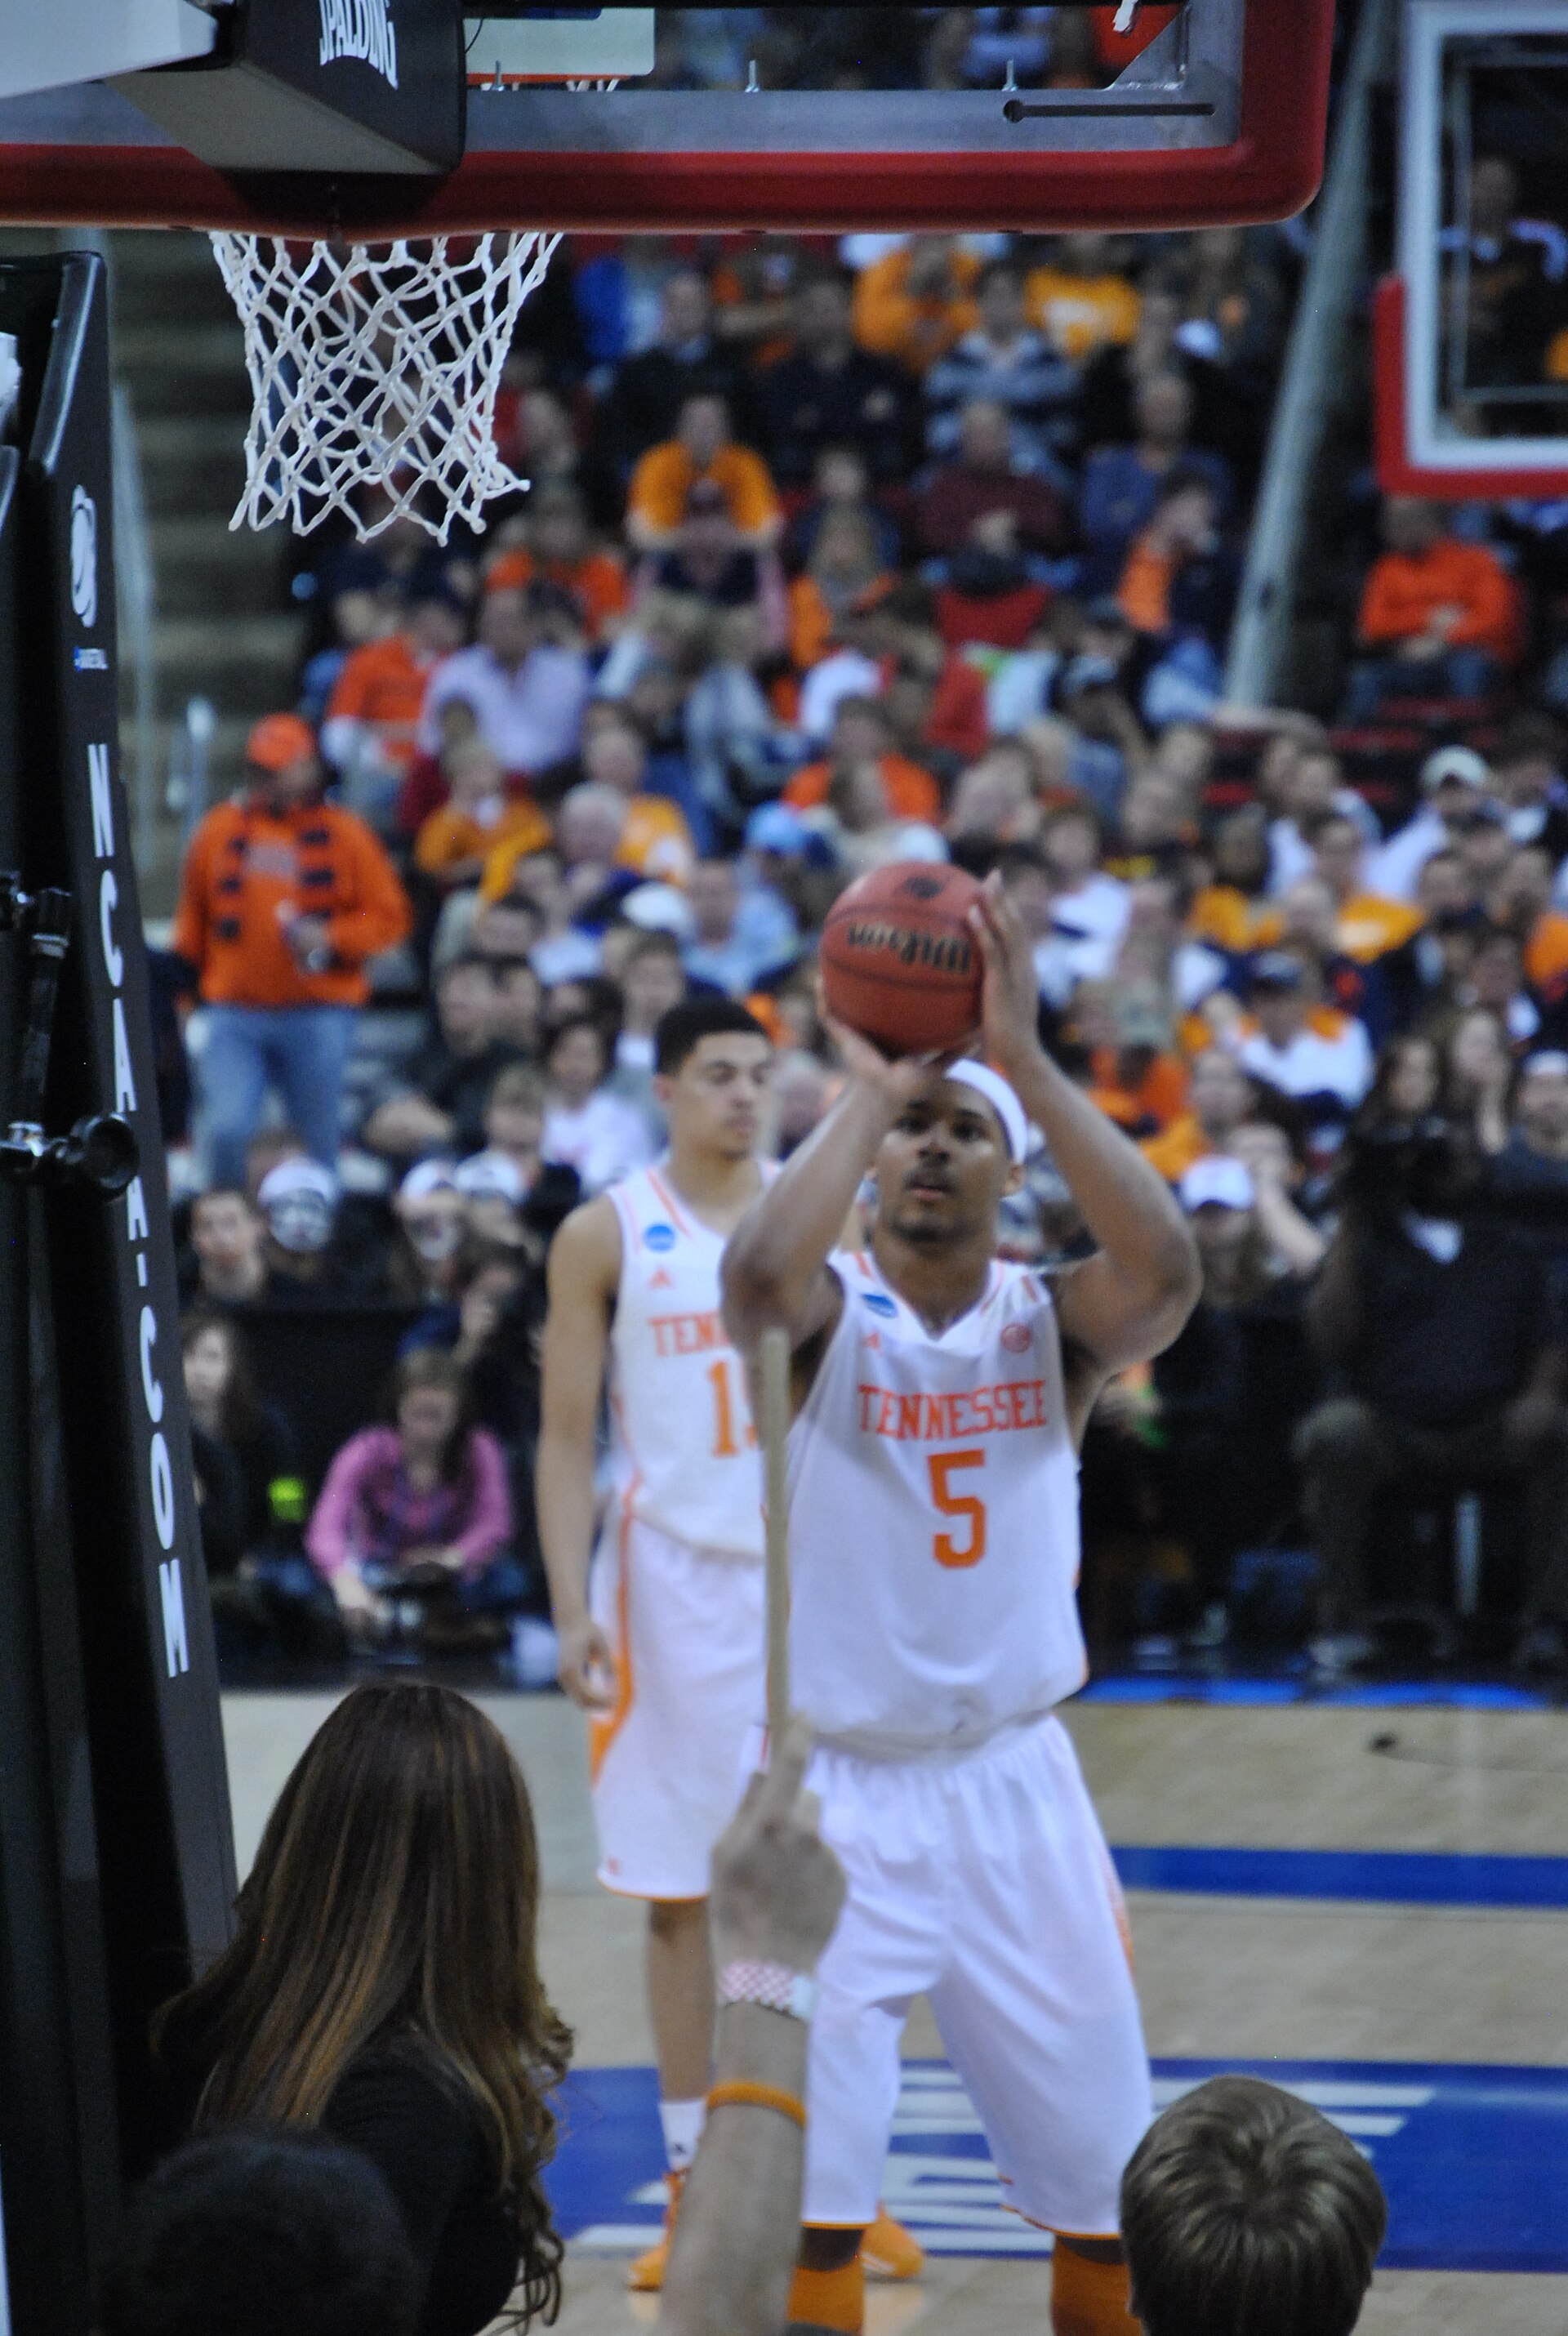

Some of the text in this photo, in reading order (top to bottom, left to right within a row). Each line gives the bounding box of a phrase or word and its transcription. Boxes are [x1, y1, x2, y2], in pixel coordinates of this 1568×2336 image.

[319, 0, 399, 90] SPALDING
[858, 1380, 1046, 1441] TENNESSEE
[927, 1449, 987, 1569] 5
